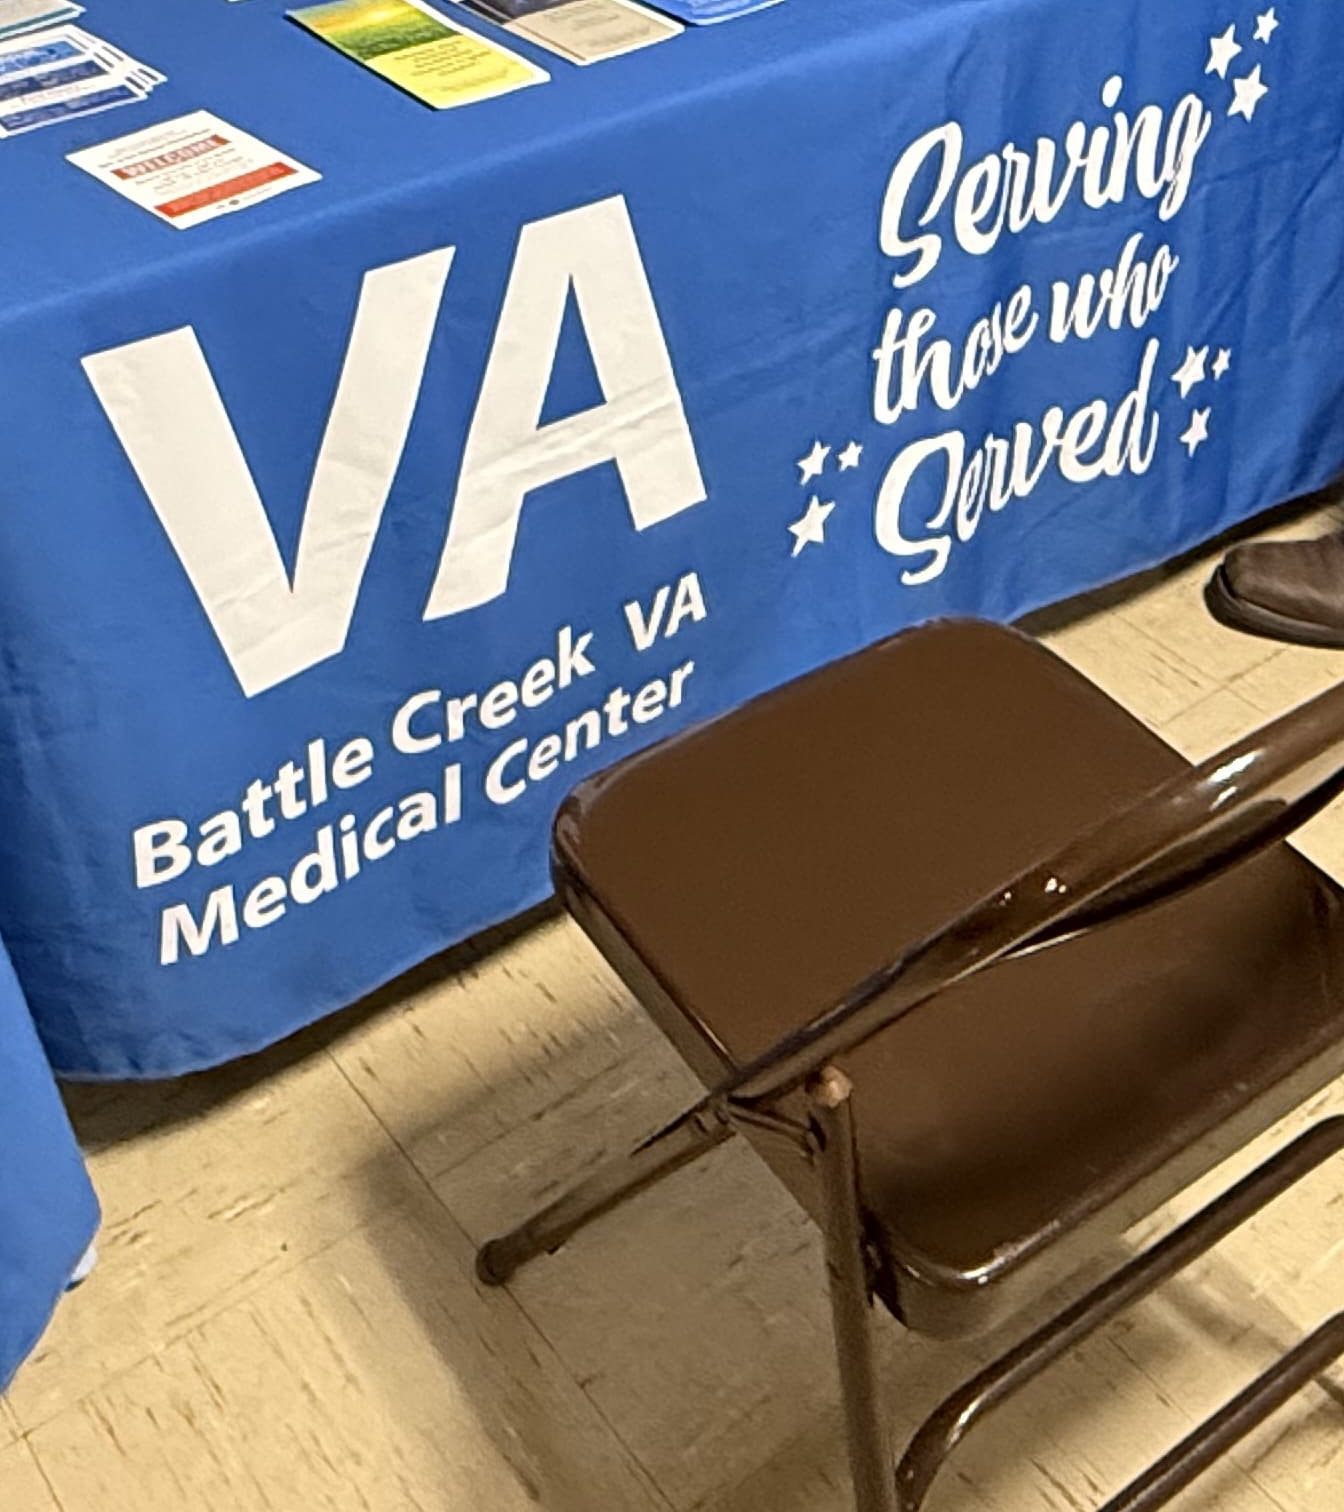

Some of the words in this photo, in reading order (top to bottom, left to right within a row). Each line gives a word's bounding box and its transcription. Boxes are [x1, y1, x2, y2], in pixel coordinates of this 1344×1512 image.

[880, 76, 1212, 289] Serving
[81, 195, 708, 699] VA
[873, 285, 1039, 425] those
[1049, 233, 1180, 343] who
[875, 339, 1160, 586] Served
[133, 737, 375, 890] Battle
[391, 626, 597, 755] Creek
[624, 572, 708, 652] VA
[160, 763, 463, 967] Medical
[485, 661, 696, 806] Center
